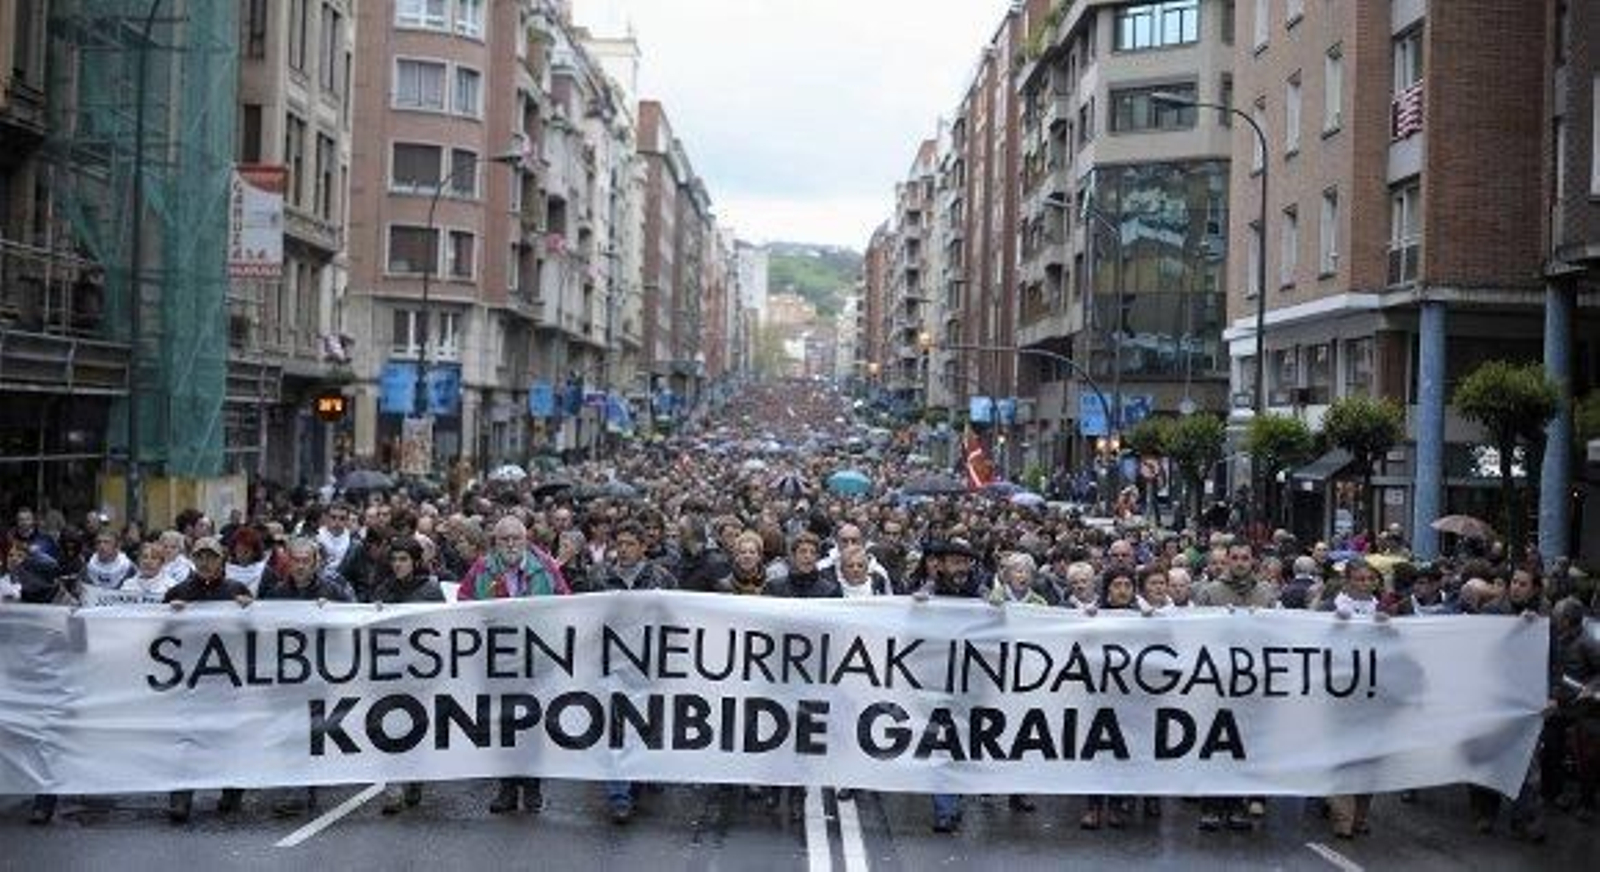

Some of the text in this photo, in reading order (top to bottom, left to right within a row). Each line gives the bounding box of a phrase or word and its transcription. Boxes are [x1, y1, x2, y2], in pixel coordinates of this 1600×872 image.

[146, 625, 1378, 699] SALBUESPEN NEURRIAK INDARGABETU!
[308, 691, 1246, 762] KONPONBIDE GARAIA DA
